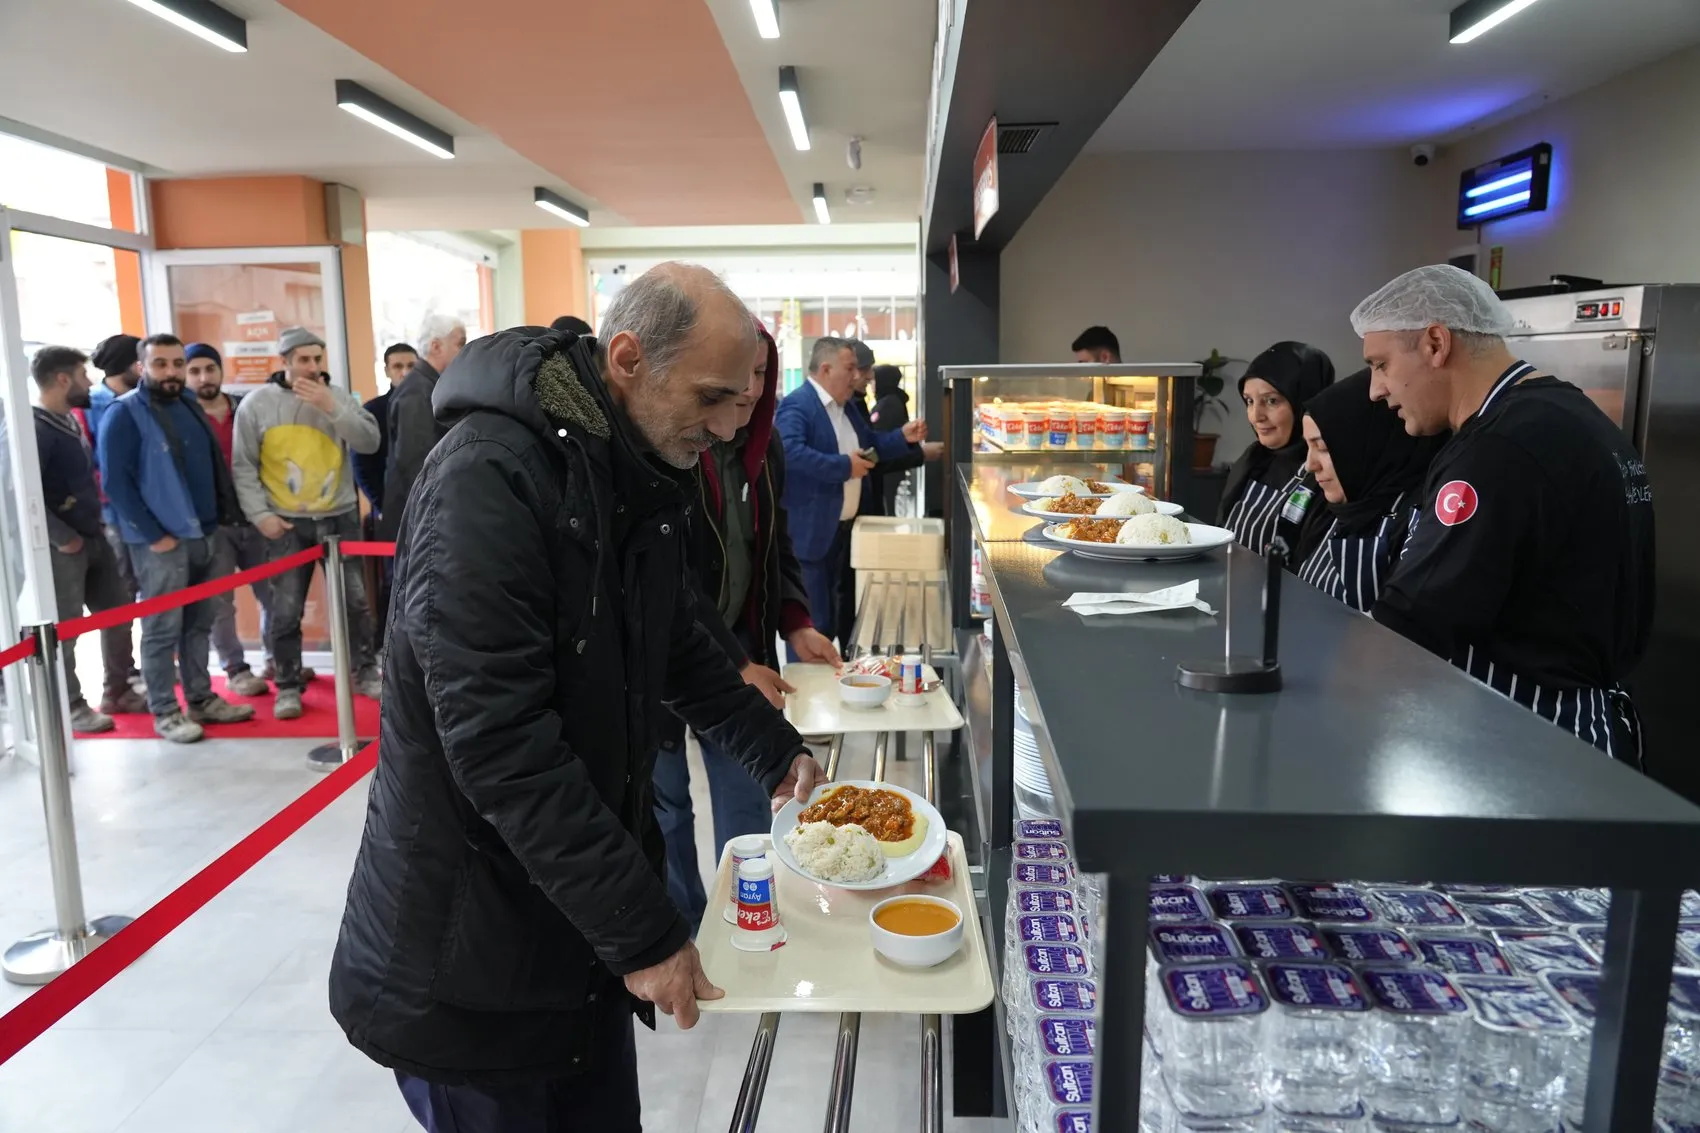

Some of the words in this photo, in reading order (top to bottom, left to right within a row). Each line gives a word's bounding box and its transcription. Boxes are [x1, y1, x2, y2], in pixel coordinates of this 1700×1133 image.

[1029, 892, 1041, 912] Sultan
[1158, 933, 1219, 943] Sultan
[1037, 948, 1051, 972] Sultan
[1047, 983, 1062, 1007] Sultan
[1183, 973, 1210, 1010] Sultan
[1053, 1022, 1071, 1054] Sultan
[1060, 1065, 1081, 1102] Sultan
